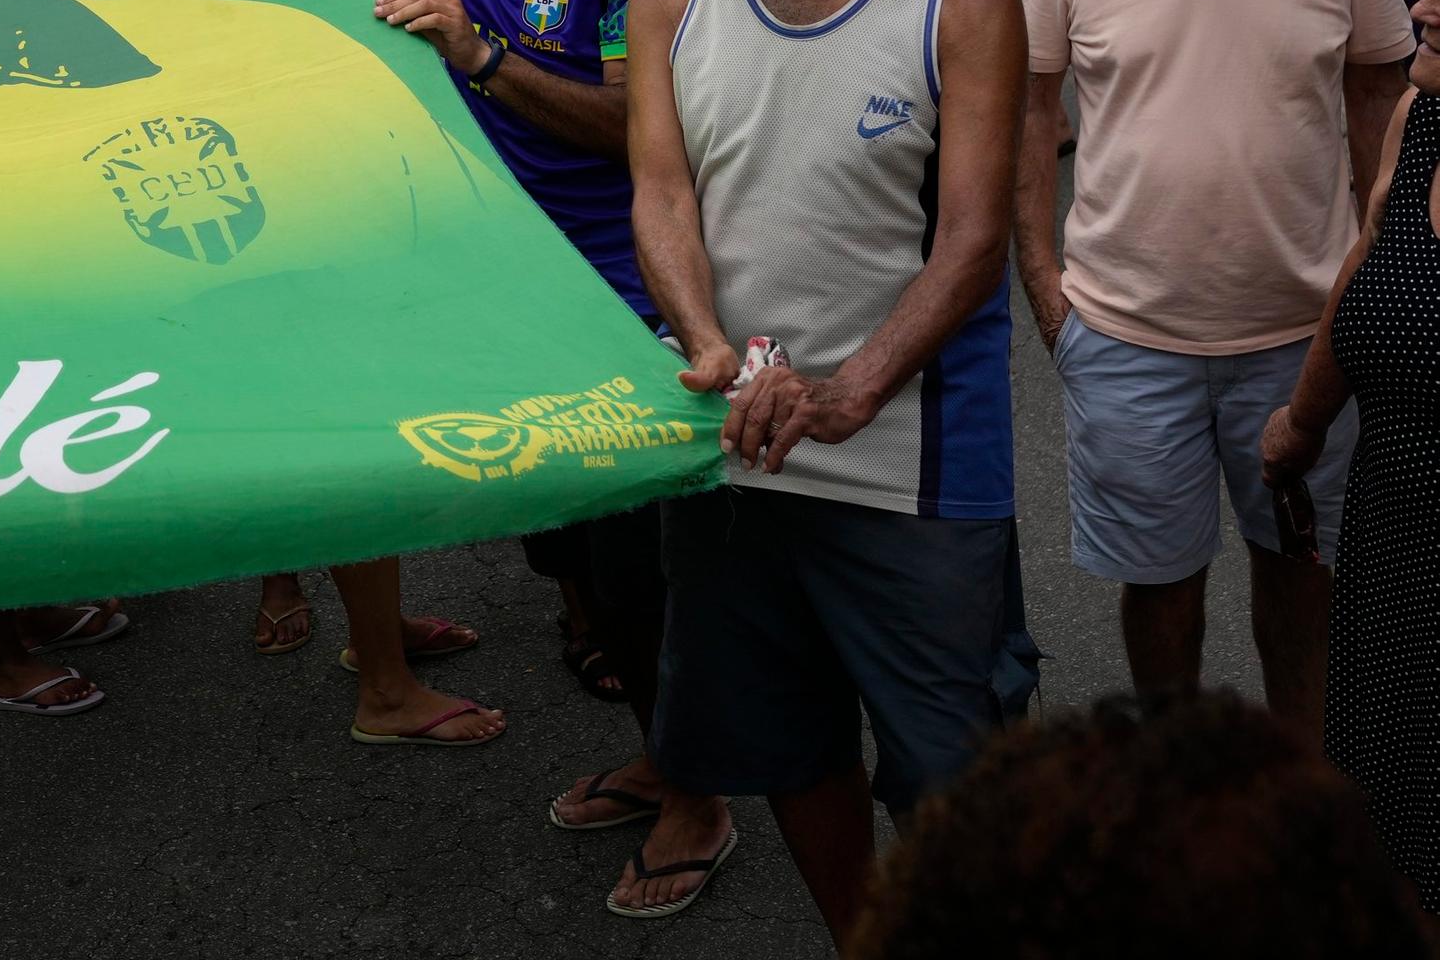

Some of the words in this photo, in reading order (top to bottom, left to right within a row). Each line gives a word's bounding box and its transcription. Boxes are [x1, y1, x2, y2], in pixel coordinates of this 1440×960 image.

[519, 32, 566, 53] BRASIL
[864, 95, 914, 118] NIKE
[583, 455, 616, 469] BRASIL
